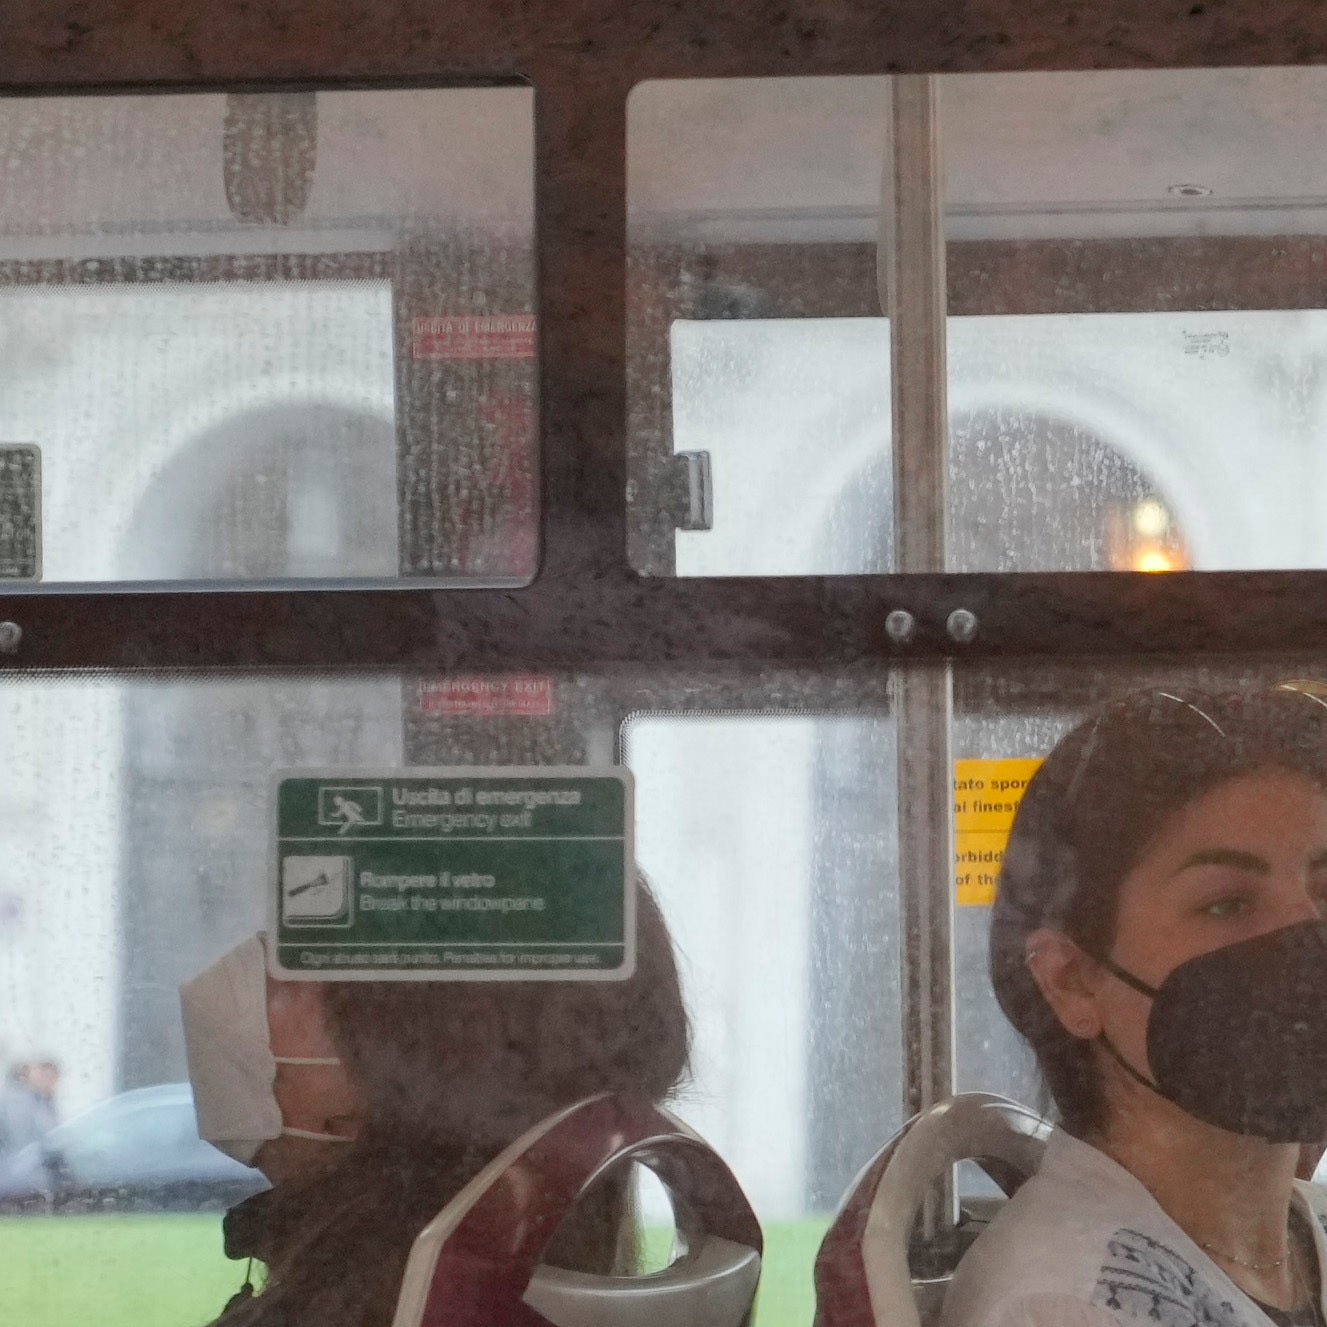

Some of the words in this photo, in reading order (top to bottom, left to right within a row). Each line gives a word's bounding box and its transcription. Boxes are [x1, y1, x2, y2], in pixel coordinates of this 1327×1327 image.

[953, 777, 985, 791] tato
[990, 778, 1028, 792] spor
[392, 786, 452, 805] Uscita
[454, 786, 474, 805] di
[475, 790, 582, 810] emergenza
[392, 809, 498, 832] Emergency
